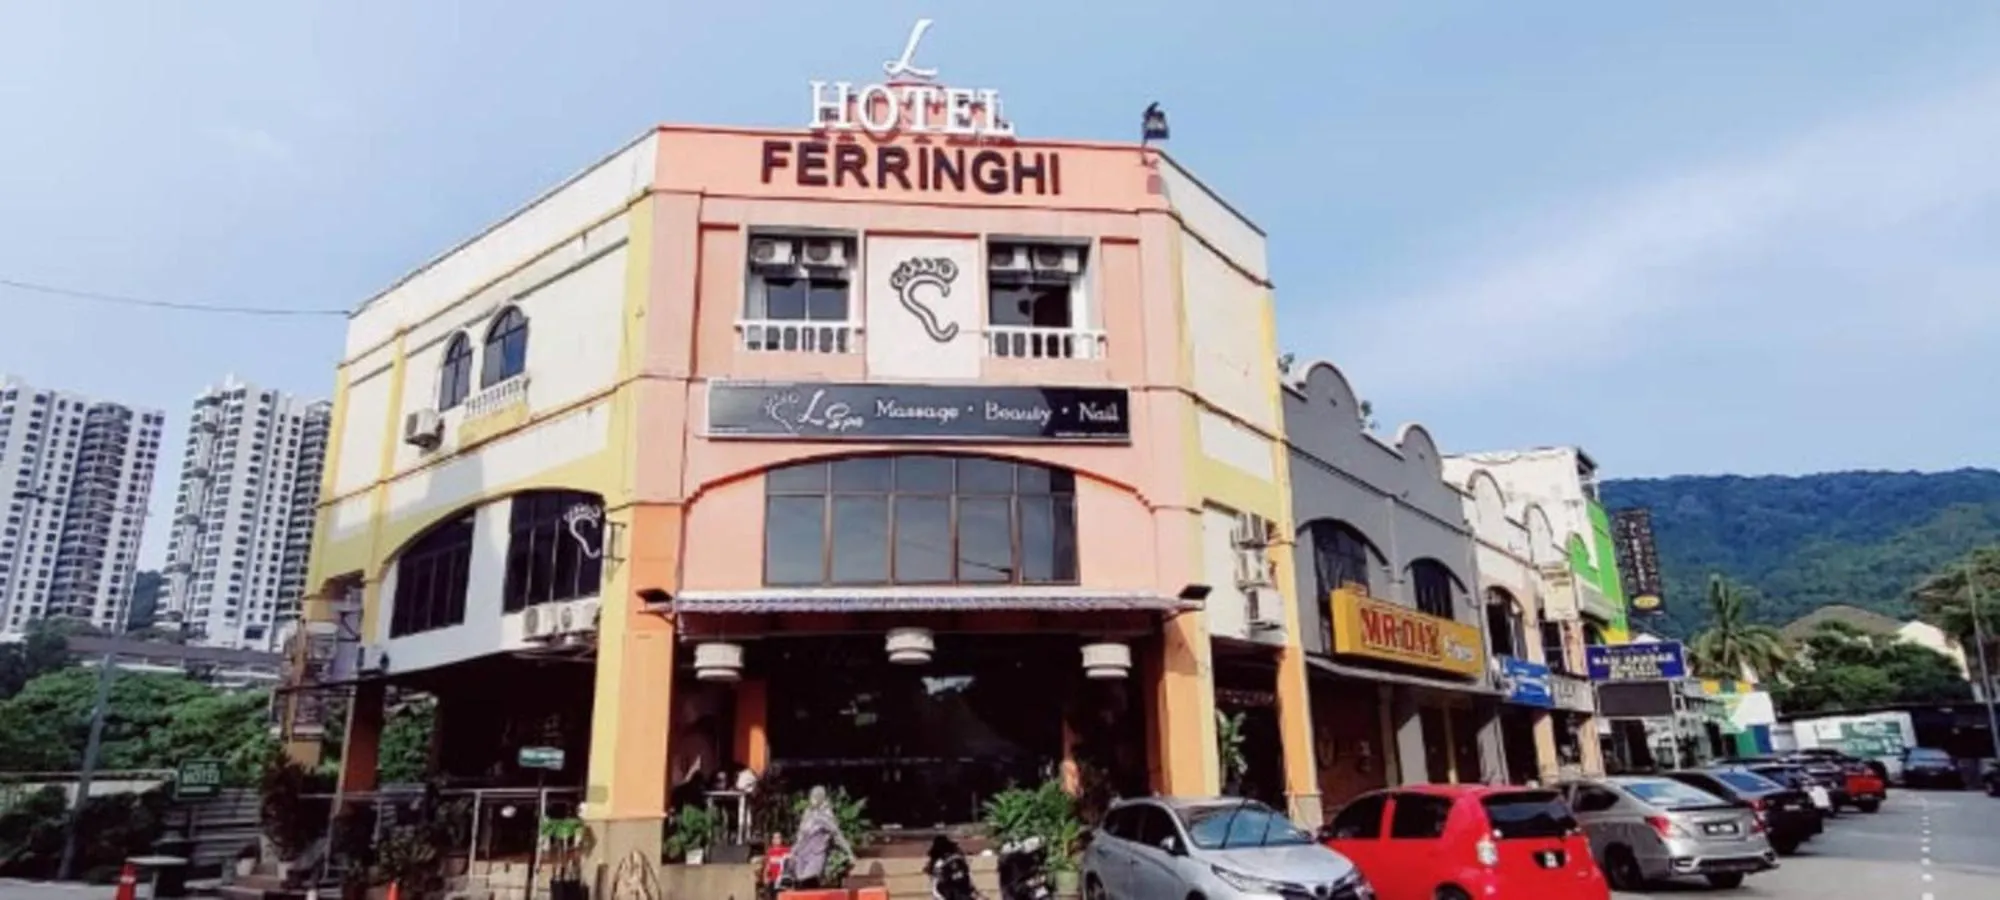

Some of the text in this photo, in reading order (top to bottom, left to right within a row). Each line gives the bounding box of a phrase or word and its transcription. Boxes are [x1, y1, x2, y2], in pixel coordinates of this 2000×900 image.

[884, 18, 938, 77] L
[808, 80, 1015, 136] HOTEL
[761, 140, 1061, 196] FERRINGHI
[876, 399, 959, 425] Massage
[985, 400, 1052, 427] Beauty
[1079, 402, 1119, 421] Nail
